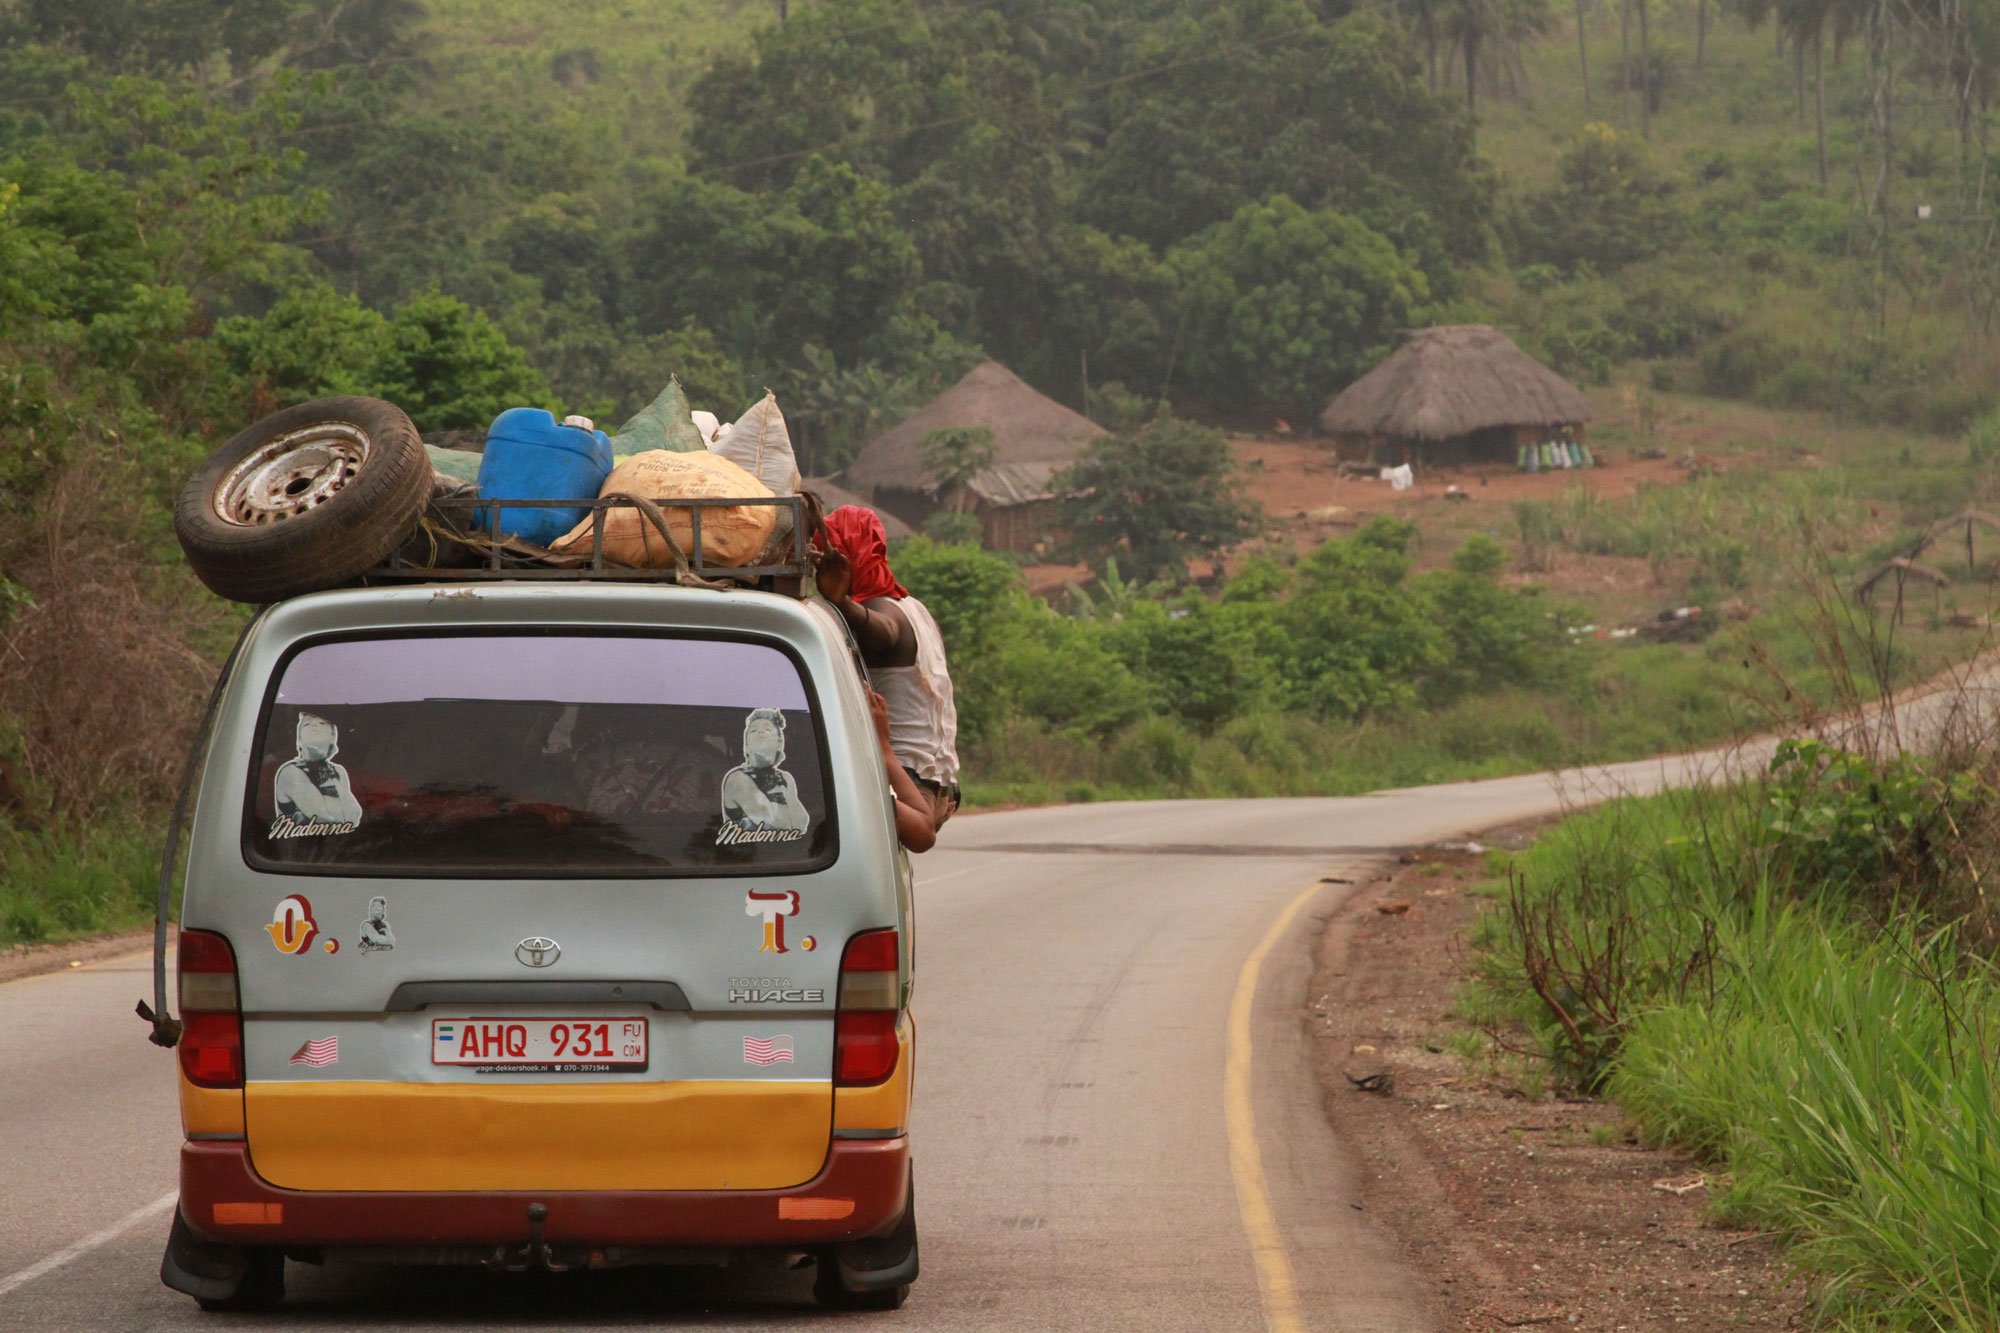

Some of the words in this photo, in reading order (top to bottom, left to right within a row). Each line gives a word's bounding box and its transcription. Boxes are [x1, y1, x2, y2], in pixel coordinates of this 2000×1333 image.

[637, 462, 669, 473] POIDS
[268, 814, 355, 840] Madonna
[715, 820, 804, 846] Madonna
[729, 977, 793, 988] TOYOTA
[728, 989, 824, 1003] HIACE
[623, 1024, 641, 1037] FU
[459, 1024, 527, 1058] AHQ
[550, 1023, 614, 1057] 931
